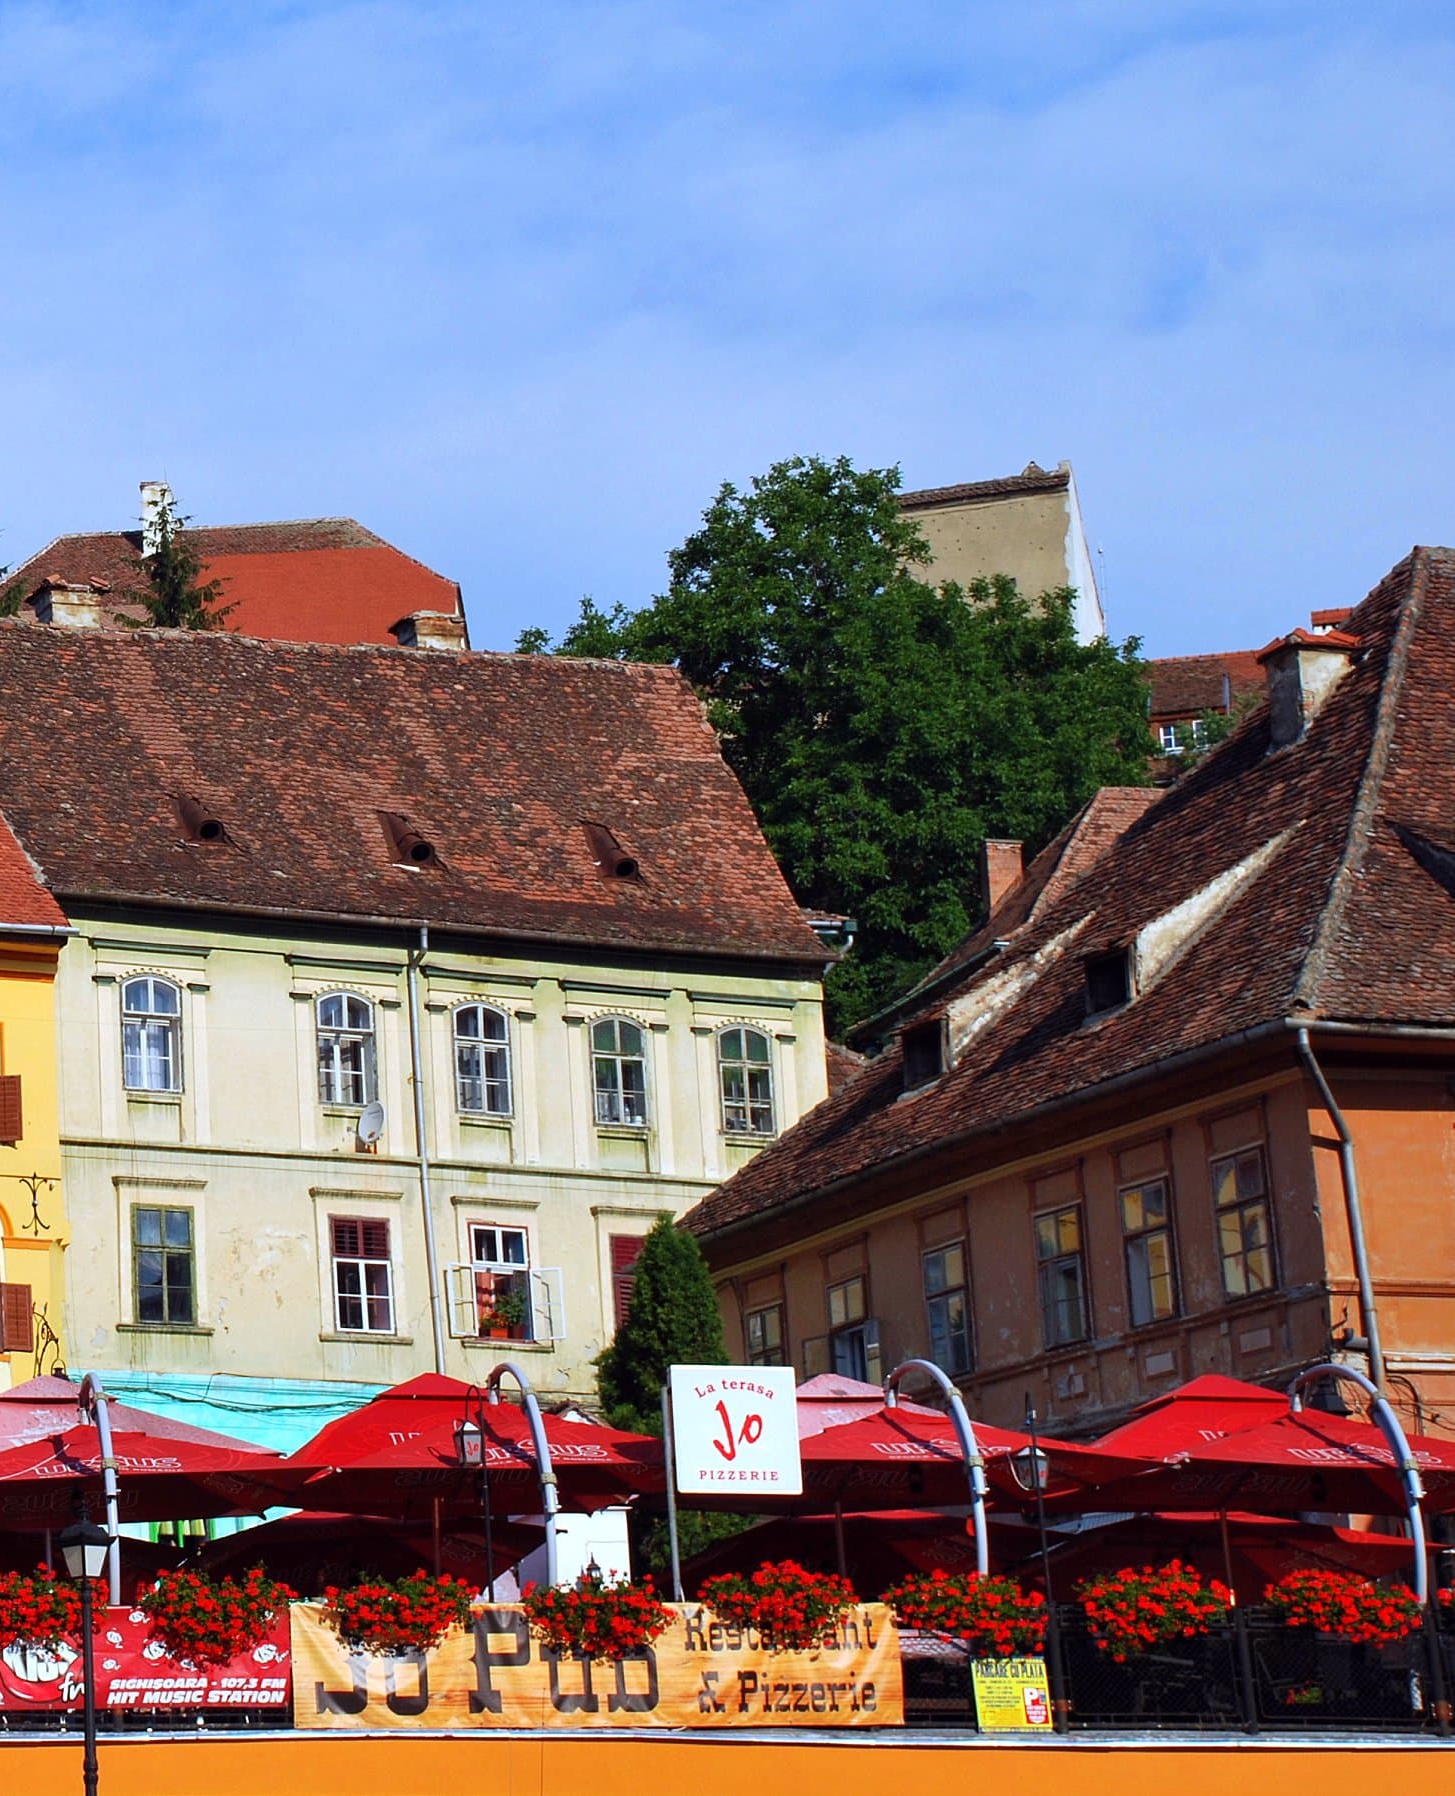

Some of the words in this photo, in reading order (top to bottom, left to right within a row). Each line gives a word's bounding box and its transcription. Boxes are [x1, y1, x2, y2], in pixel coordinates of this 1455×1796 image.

[694, 1384, 715, 1398] La
[721, 1379, 775, 1400] terasa
[713, 1400, 763, 1461] Jo
[699, 1470, 779, 1481] PIZZERIE
[684, 1608, 878, 1652] Restaant
[260, 1678, 287, 1689] FM
[737, 1670, 878, 1713] Pizzerie
[107, 1691, 139, 1704] HIT
[143, 1691, 204, 1703] MUSIC
